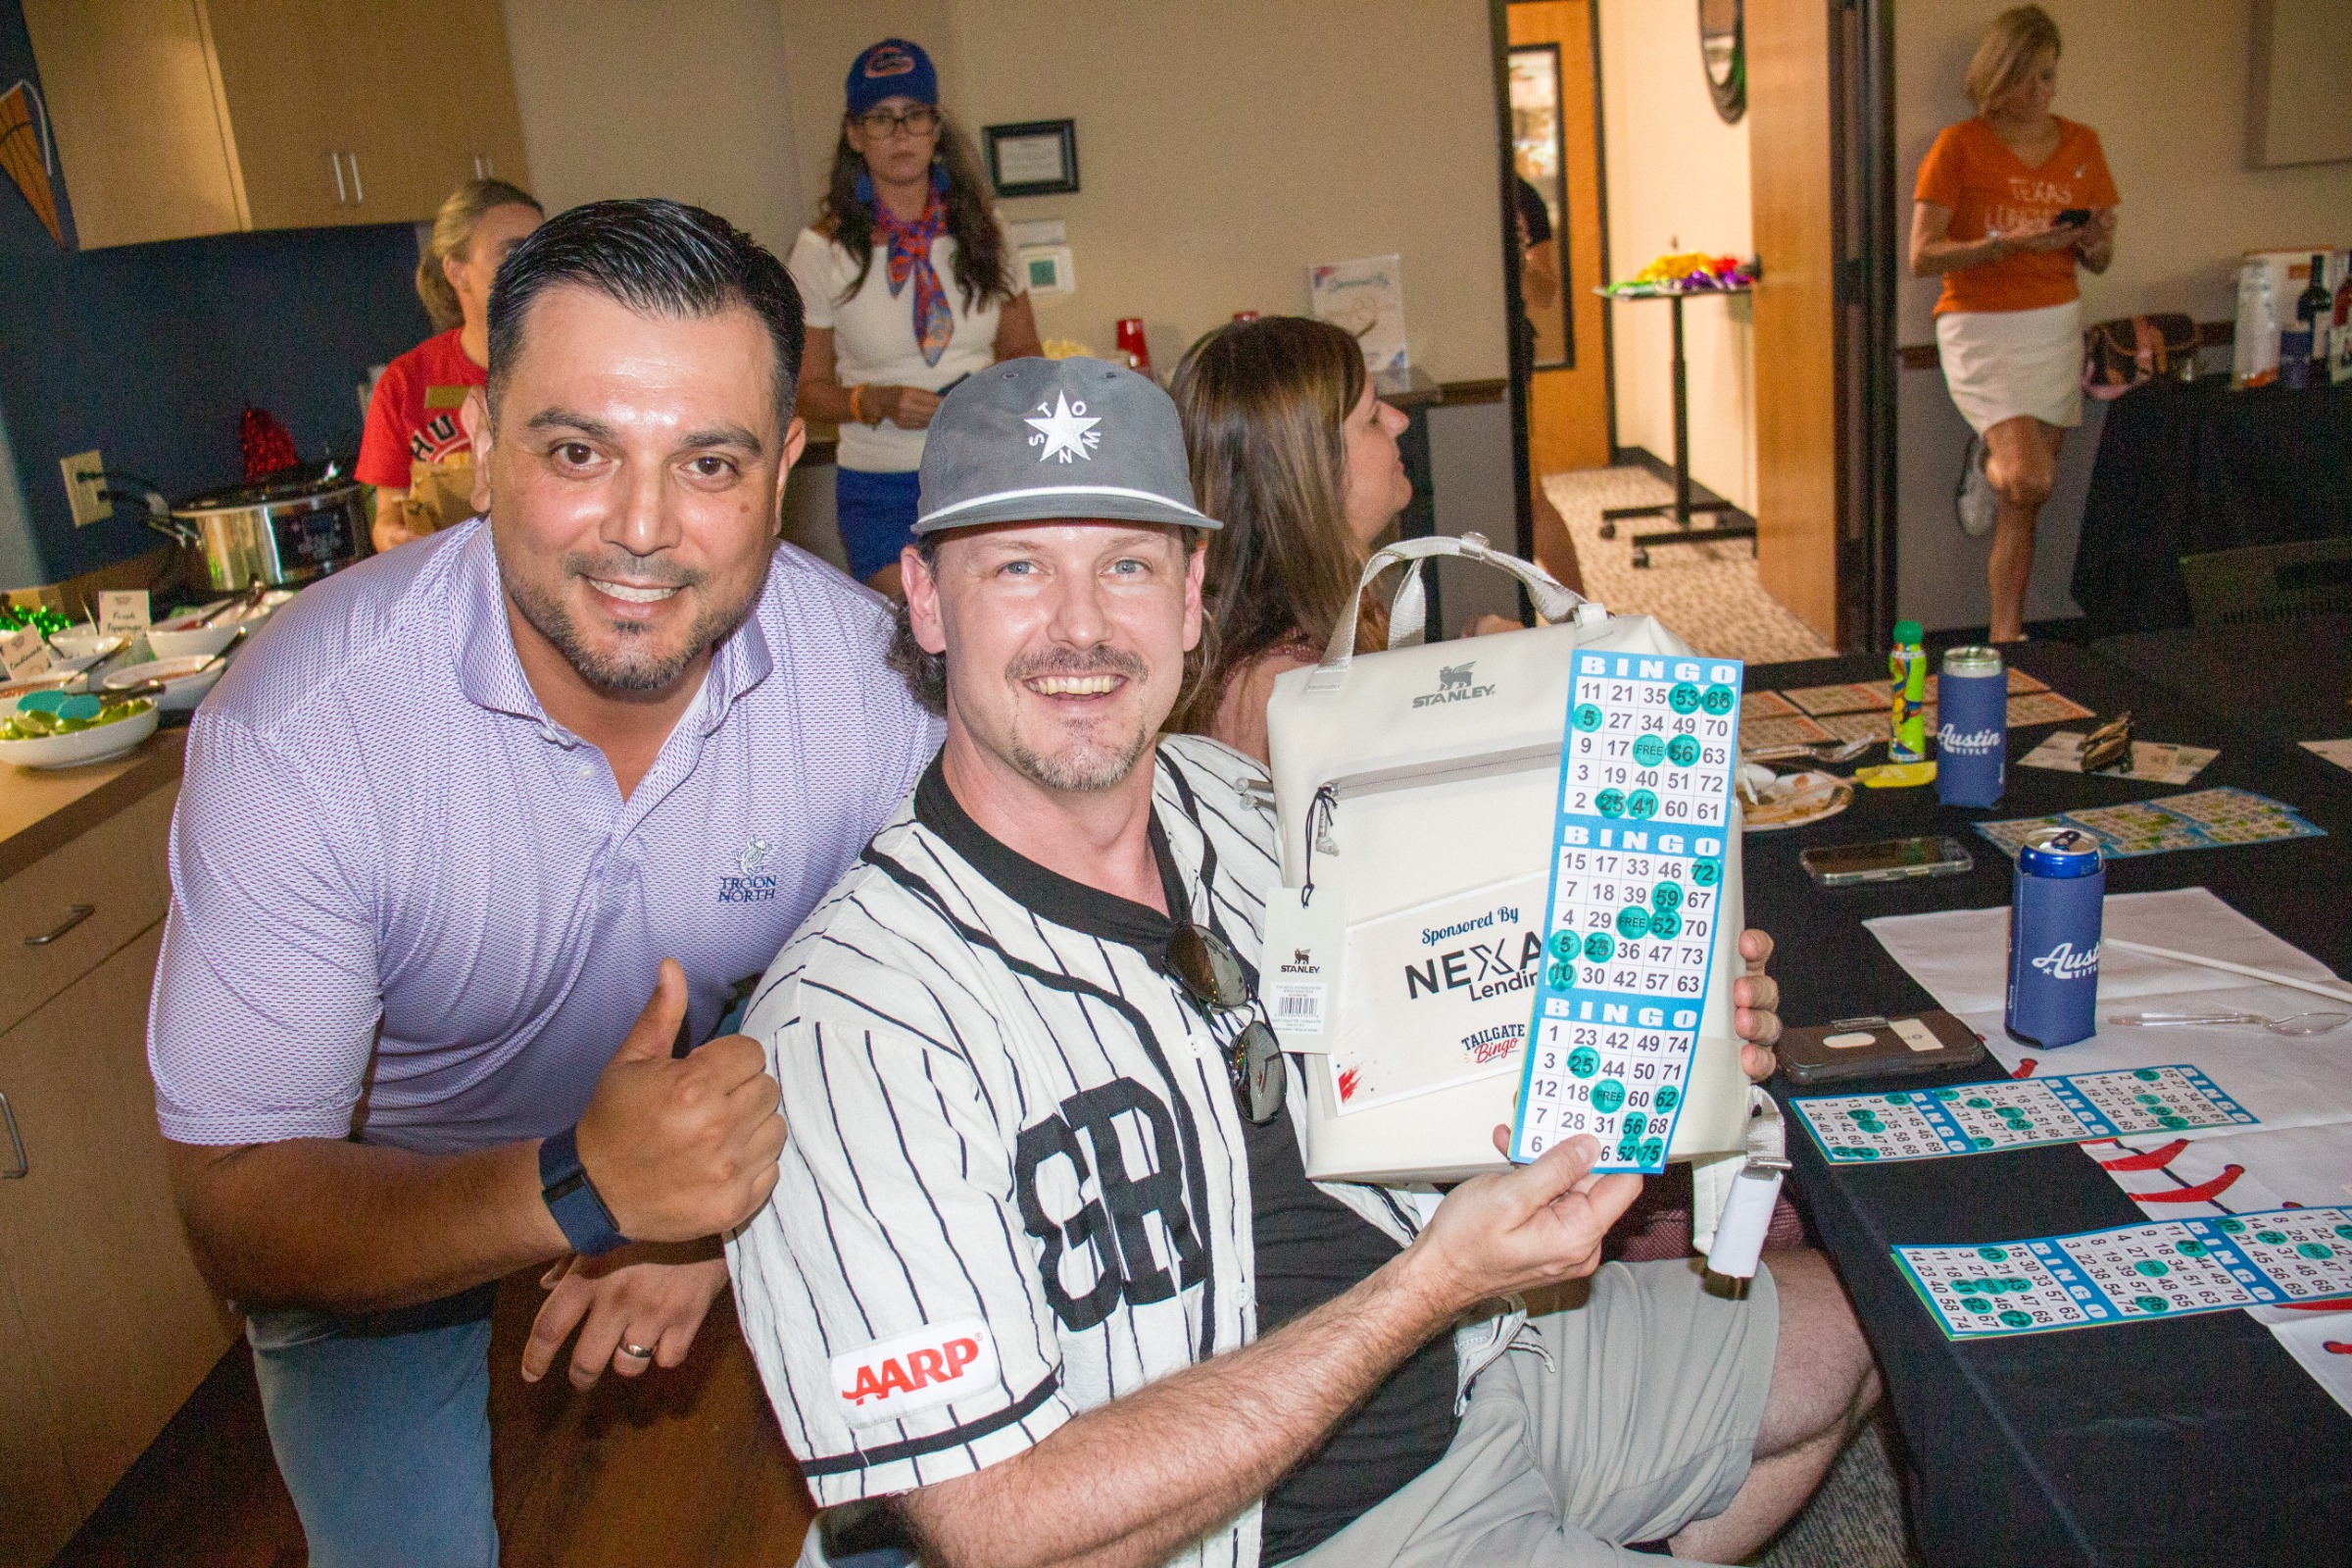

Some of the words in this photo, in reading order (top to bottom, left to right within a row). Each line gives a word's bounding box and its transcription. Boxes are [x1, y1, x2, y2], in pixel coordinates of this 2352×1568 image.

[1581, 656, 1737, 684] BINGO
[1412, 684, 1495, 709] STANLEY
[1583, 683, 1599, 699] 11
[1612, 685, 1632, 702] 21
[1643, 688, 1666, 704] 35
[1676, 690, 1697, 707] 53
[1706, 692, 1730, 709] 66
[1584, 710, 1594, 726] 5
[1609, 712, 1632, 729] 27
[1642, 715, 1663, 731] 34
[1673, 717, 1695, 734] 49
[1706, 719, 1728, 736] 70
[1581, 738, 1591, 753] 9
[1608, 740, 1629, 756] 17
[1637, 745, 1663, 756] FREE
[1670, 745, 1693, 761] 56
[1703, 748, 1725, 764] 63
[1936, 723, 2001, 753] Austin
[1578, 764, 1588, 780] 3
[1605, 767, 1626, 784] 19
[1636, 770, 1658, 787] 40
[1668, 773, 1688, 789] 51
[1700, 775, 1723, 792] 72
[1575, 792, 1586, 808] 2
[1600, 795, 1623, 811] 25
[1632, 798, 1653, 814] 41
[1665, 801, 1688, 817] 60
[1697, 803, 1718, 820] 61
[1564, 825, 1721, 857] BINGO
[1564, 853, 1586, 869] 15
[1596, 856, 1618, 872] 17
[1627, 858, 1648, 875] 33
[1658, 862, 1682, 878] 46
[1692, 864, 1713, 881] 72
[718, 888, 776, 903] NORTH
[719, 875, 777, 890] TROON
[1567, 881, 1577, 897] 7
[1593, 884, 1614, 901] 18
[1624, 887, 1646, 904] 39
[1656, 890, 1678, 906] 59
[1688, 892, 1710, 908] 67
[1421, 911, 1494, 947] Sponsored
[1497, 906, 1519, 924] By
[1562, 909, 1574, 925] 4
[1589, 911, 1611, 928] 29
[1619, 917, 1645, 929] FREE
[1652, 917, 1675, 934] 52
[1686, 920, 1706, 937] 70
[1560, 936, 1571, 953] 5
[1585, 939, 1608, 956] 25
[1618, 943, 1640, 959] 36
[1648, 946, 1672, 962] 47
[1683, 948, 1702, 964] 73
[2032, 941, 2100, 980] Aust
[1280, 964, 1321, 974] STANLEY
[1404, 931, 1542, 1001] NEXA
[1551, 964, 1573, 981] 10
[1583, 967, 1604, 984] 30
[1614, 971, 1637, 988] 42
[1646, 973, 1669, 990] 57
[1678, 976, 1698, 992] 63
[1544, 998, 1697, 1029] BINGO
[1461, 1023, 1526, 1052] TAILGATE
[1474, 1037, 1518, 1064] Bingo
[1549, 1025, 1558, 1042] 1
[1573, 1028, 1597, 1046] 23
[1605, 1031, 1630, 1050] 42
[1637, 1035, 1660, 1053] 49
[1668, 1037, 1689, 1053] 74
[1544, 1053, 1555, 1069] 3
[1570, 1055, 1594, 1073] 25
[1602, 1060, 1625, 1078] 44
[1633, 1063, 1655, 1080] 50
[1662, 1064, 1682, 1080] 71
[1535, 1079, 1557, 1098] 12
[1567, 1084, 1589, 1102] 18
[1596, 1090, 1623, 1102] FREE
[1628, 1091, 1649, 1107] 60
[1655, 1092, 1677, 1107] 62
[1536, 1107, 1547, 1124] 7
[1561, 1111, 1586, 1130] 28
[1594, 1116, 1614, 1134] 31
[1622, 1117, 1643, 1135] 56
[1648, 1118, 1668, 1134] 68
[1531, 1136, 1543, 1152] 6
[1617, 1146, 1636, 1161] 52
[1642, 1146, 1661, 1160] 75
[2153, 1243, 2175, 1255] 18
[2167, 1259, 2190, 1273] 34
[2182, 1275, 2205, 1288] 51
[2198, 1291, 2221, 1304] 63
[2165, 1225, 2185, 1237] 11
[2194, 1256, 2216, 1270] 44
[2210, 1272, 2232, 1285] 49
[2225, 1288, 2248, 1301] 70
[2233, 1235, 2257, 1247] 21
[2252, 1250, 2275, 1264] 45
[2267, 1267, 2290, 1280] 56
[2283, 1283, 2308, 1296] 69
[1906, 1250, 1926, 1262] 14
[1916, 1264, 1937, 1277] 23
[1928, 1280, 1947, 1294] 40
[1938, 1297, 1960, 1312] 58
[1950, 1315, 1972, 1329] 74
[1932, 1250, 1950, 1261] 11
[1942, 1265, 1963, 1278] 18
[1978, 1315, 2000, 1328] 67
[1967, 1264, 1988, 1278] 27
[1993, 1297, 2014, 1310] 46
[1992, 1263, 2015, 1275] 21
[2020, 1294, 2040, 1306] 47
[2032, 1309, 2053, 1323] 68
[2008, 1246, 2029, 1258] 15
[2020, 1260, 2040, 1272] 30
[2032, 1274, 2053, 1287] 33
[2044, 1291, 2067, 1303] 57
[2059, 1306, 2081, 1320] 63
[842, 1338, 979, 1406] AARP
